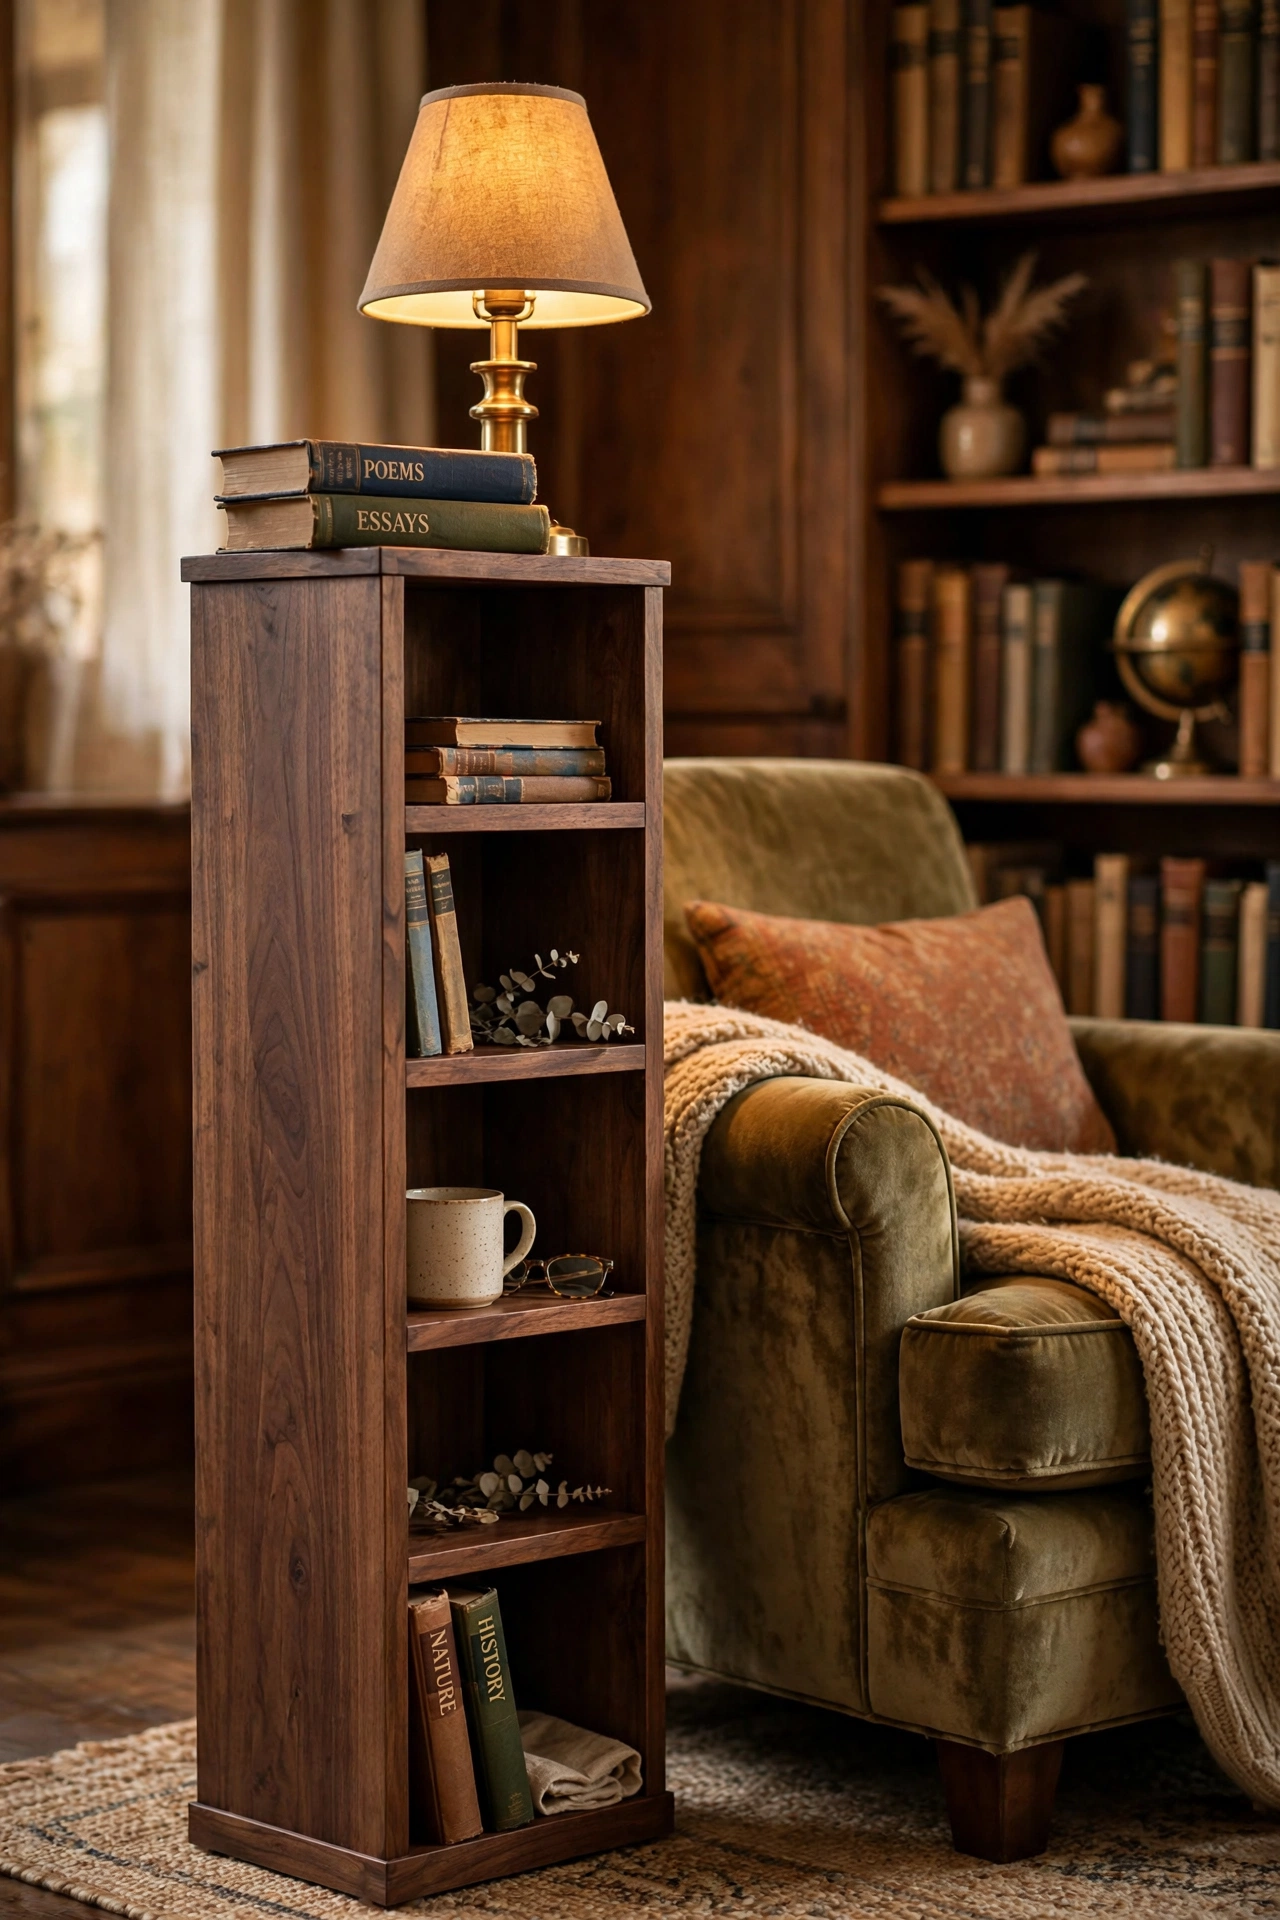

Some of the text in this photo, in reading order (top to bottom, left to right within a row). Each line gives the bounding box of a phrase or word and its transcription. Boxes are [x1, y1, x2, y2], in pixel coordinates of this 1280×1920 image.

[363, 459, 425, 482] POEMS
[356, 510, 430, 534] ESSAYS
[430, 1629, 457, 1715] NATURE
[478, 1615, 505, 1702] HISTORY
